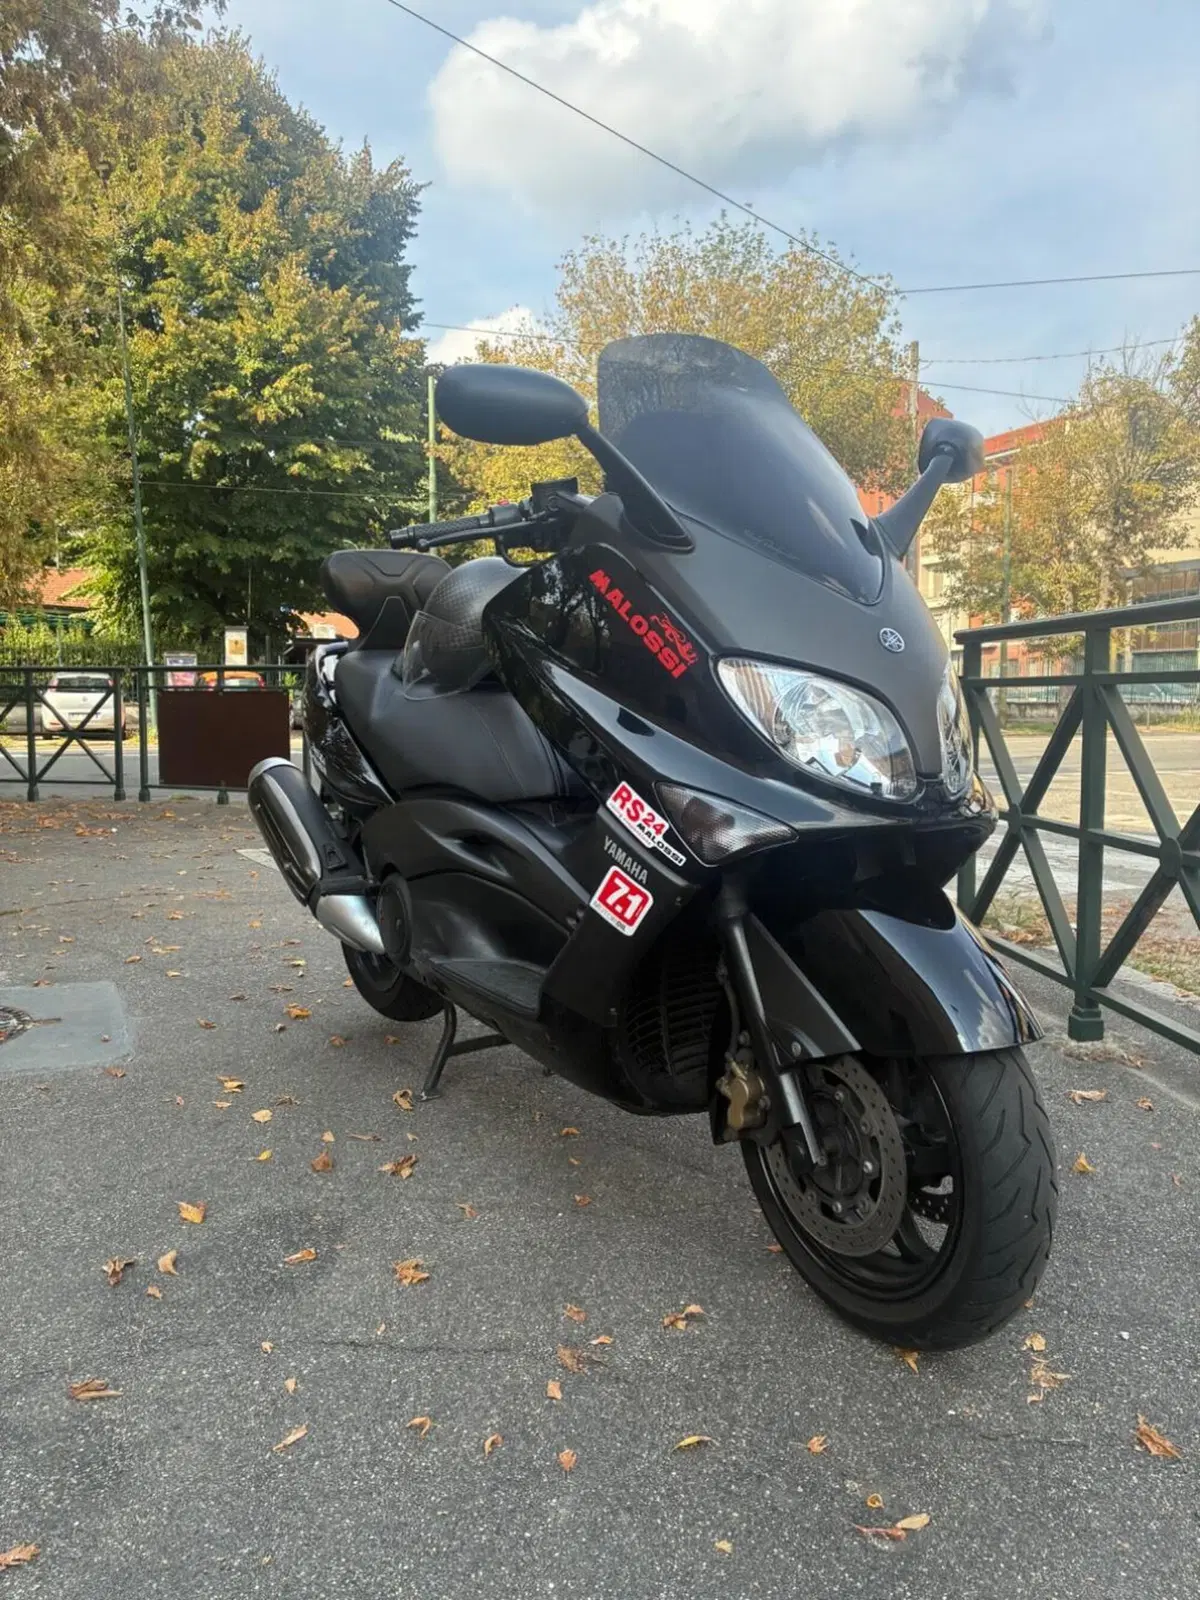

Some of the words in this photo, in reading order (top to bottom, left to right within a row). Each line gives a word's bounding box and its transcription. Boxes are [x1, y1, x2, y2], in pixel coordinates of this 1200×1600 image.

[588, 569, 687, 679] MALOSSI
[603, 836, 648, 884] YAMAHA
[637, 823, 683, 864] MALOSSI
